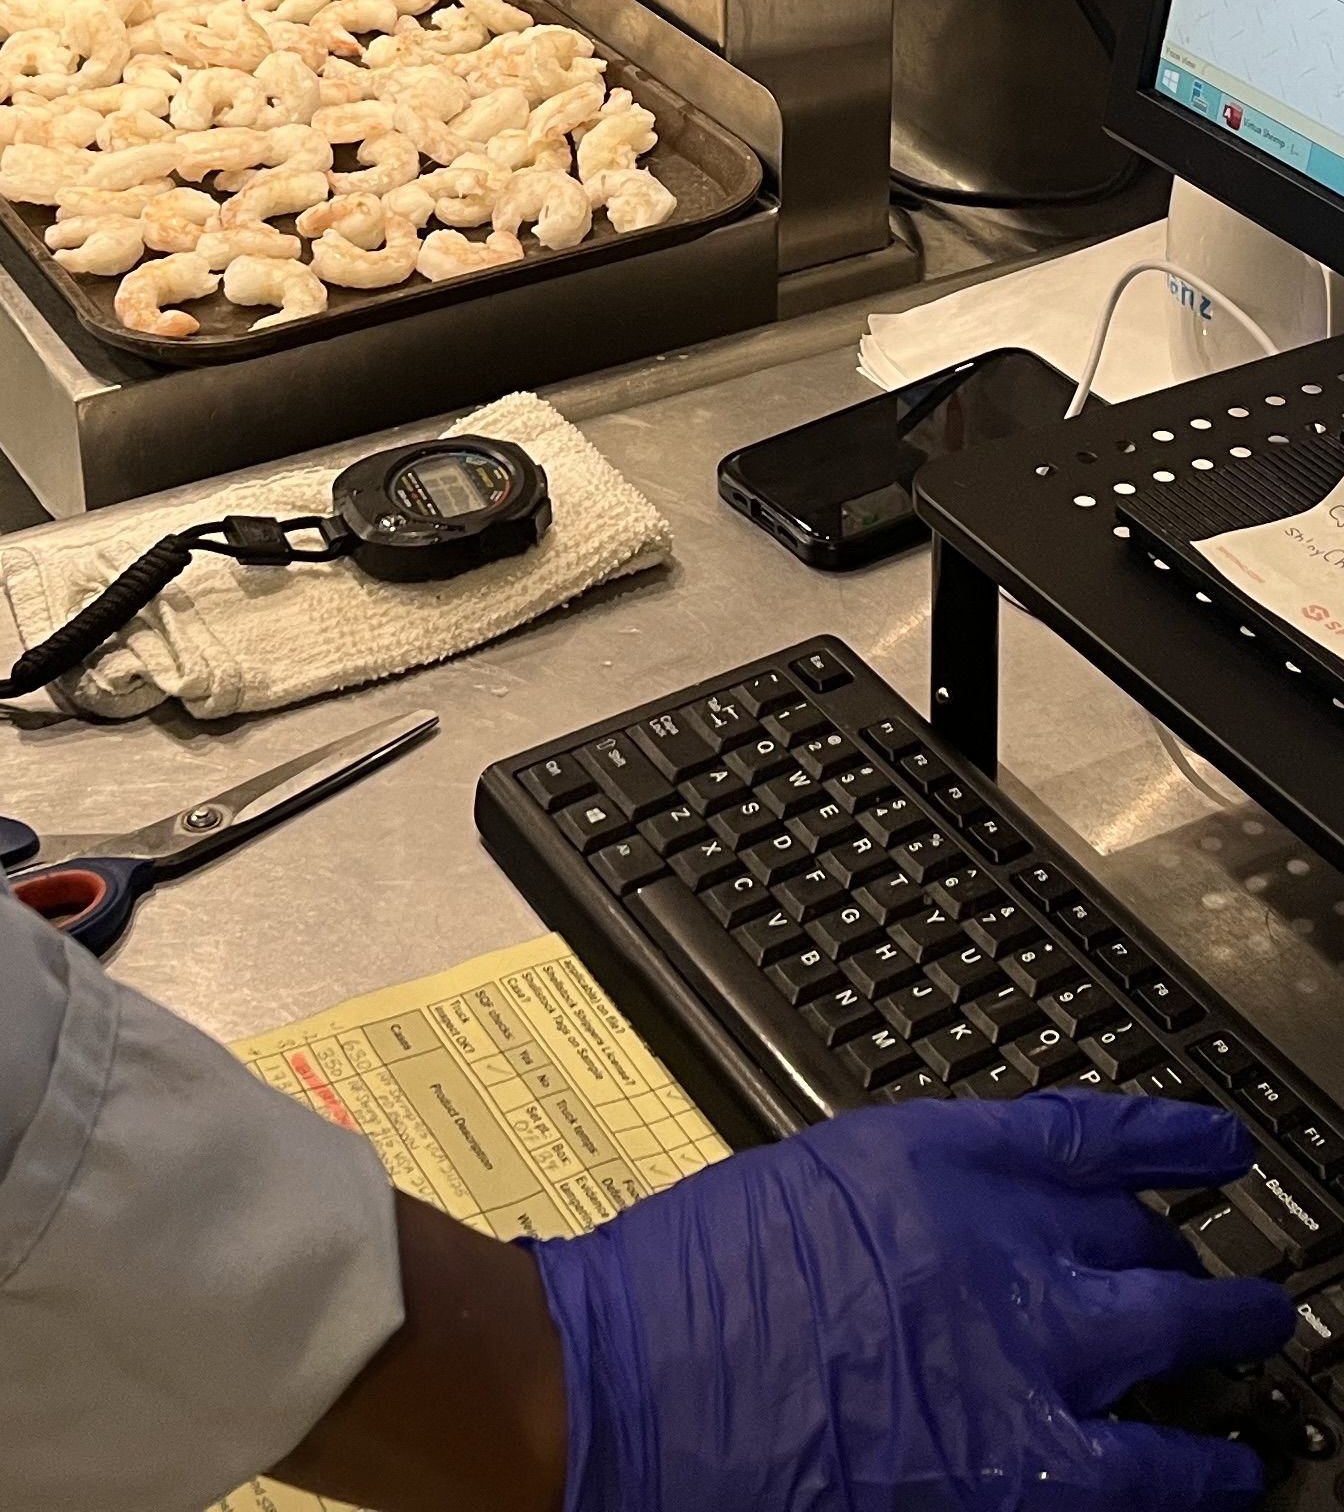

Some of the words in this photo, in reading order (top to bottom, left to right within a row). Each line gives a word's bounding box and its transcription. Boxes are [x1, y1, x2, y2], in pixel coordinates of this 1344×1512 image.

[538, 1074, 550, 1088] No
[1266, 1179, 1319, 1231] Backspace
[1297, 1303, 1332, 1338] Delete
